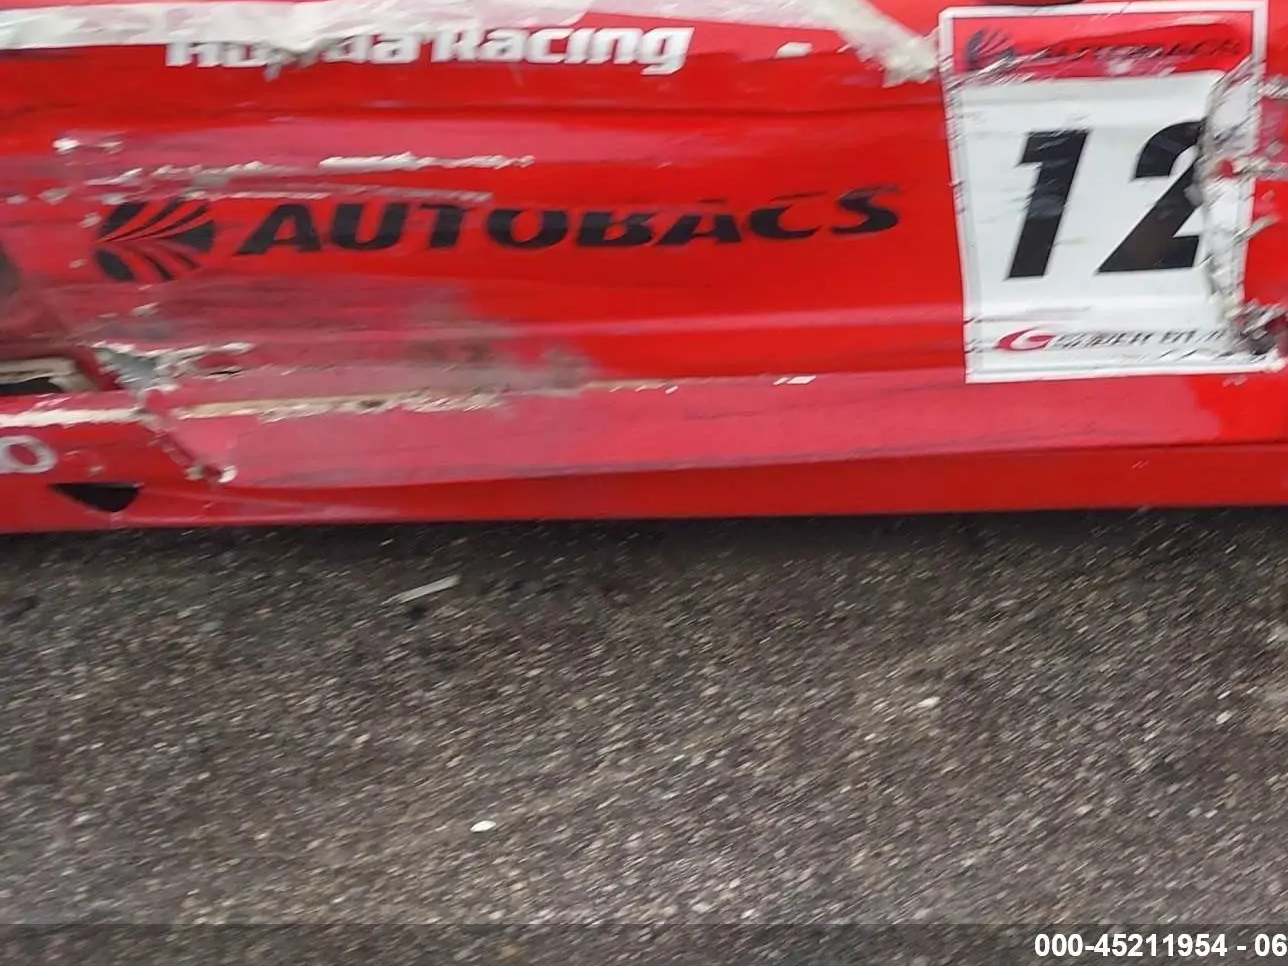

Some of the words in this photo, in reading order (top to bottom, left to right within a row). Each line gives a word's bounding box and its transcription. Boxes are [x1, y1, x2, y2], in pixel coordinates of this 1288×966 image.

[429, 26, 696, 76] Racing
[233, 183, 904, 258] AUTOBACS
[1003, 118, 1207, 281] 12
